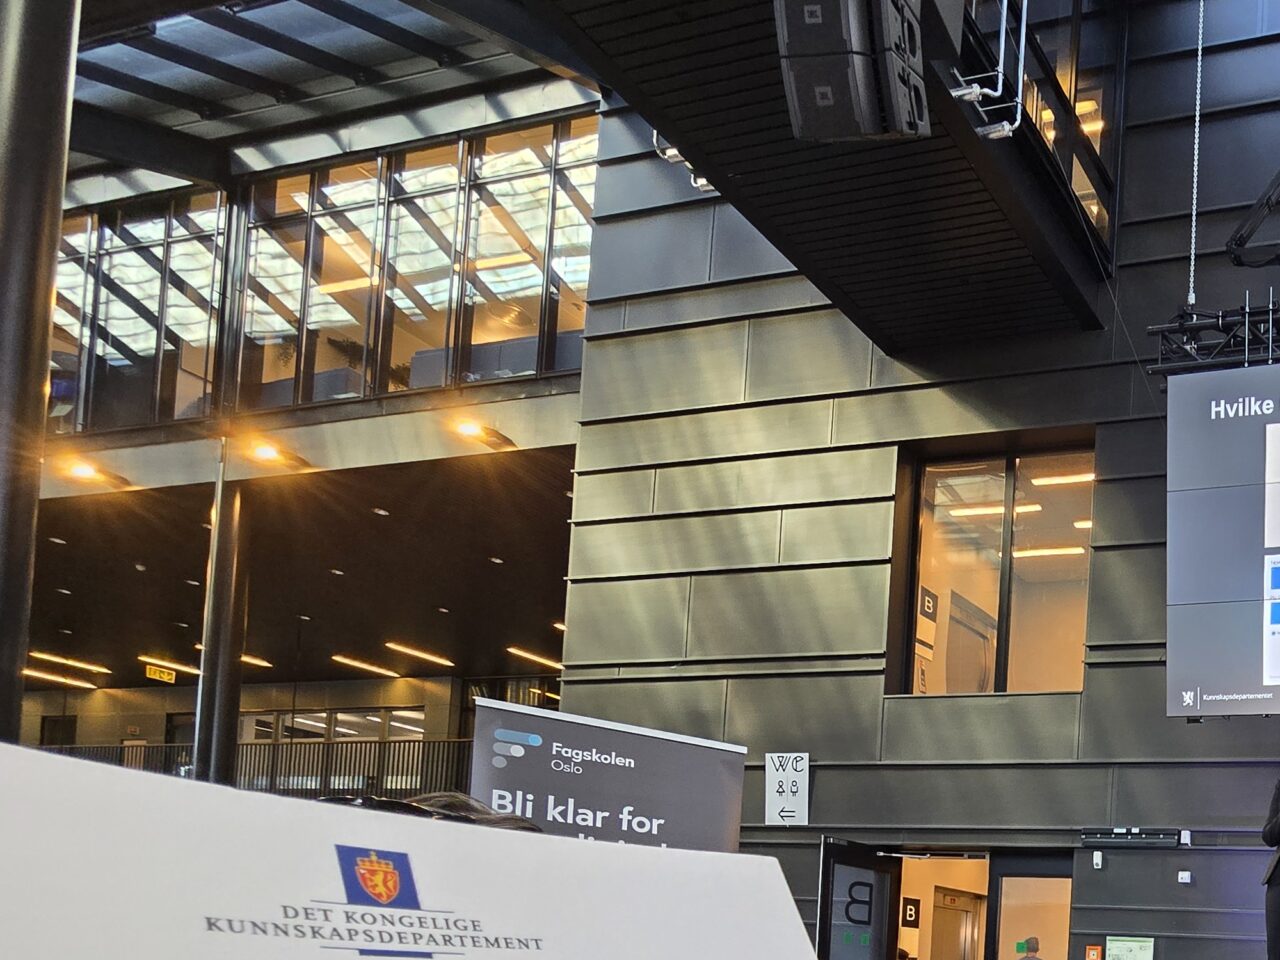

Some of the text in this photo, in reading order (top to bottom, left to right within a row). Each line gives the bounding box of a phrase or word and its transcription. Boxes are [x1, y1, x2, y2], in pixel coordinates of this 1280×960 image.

[1210, 396, 1274, 420] Hvilke
[924, 595, 934, 613] B
[550, 759, 583, 775] Oslo
[551, 742, 635, 768] Fagskolen
[491, 789, 665, 835] Bli klar for
[280, 904, 484, 933] DET KONGELIGE
[906, 904, 916, 921] B
[204, 916, 544, 951] KUNNSKAPSDEPARTEMENT
